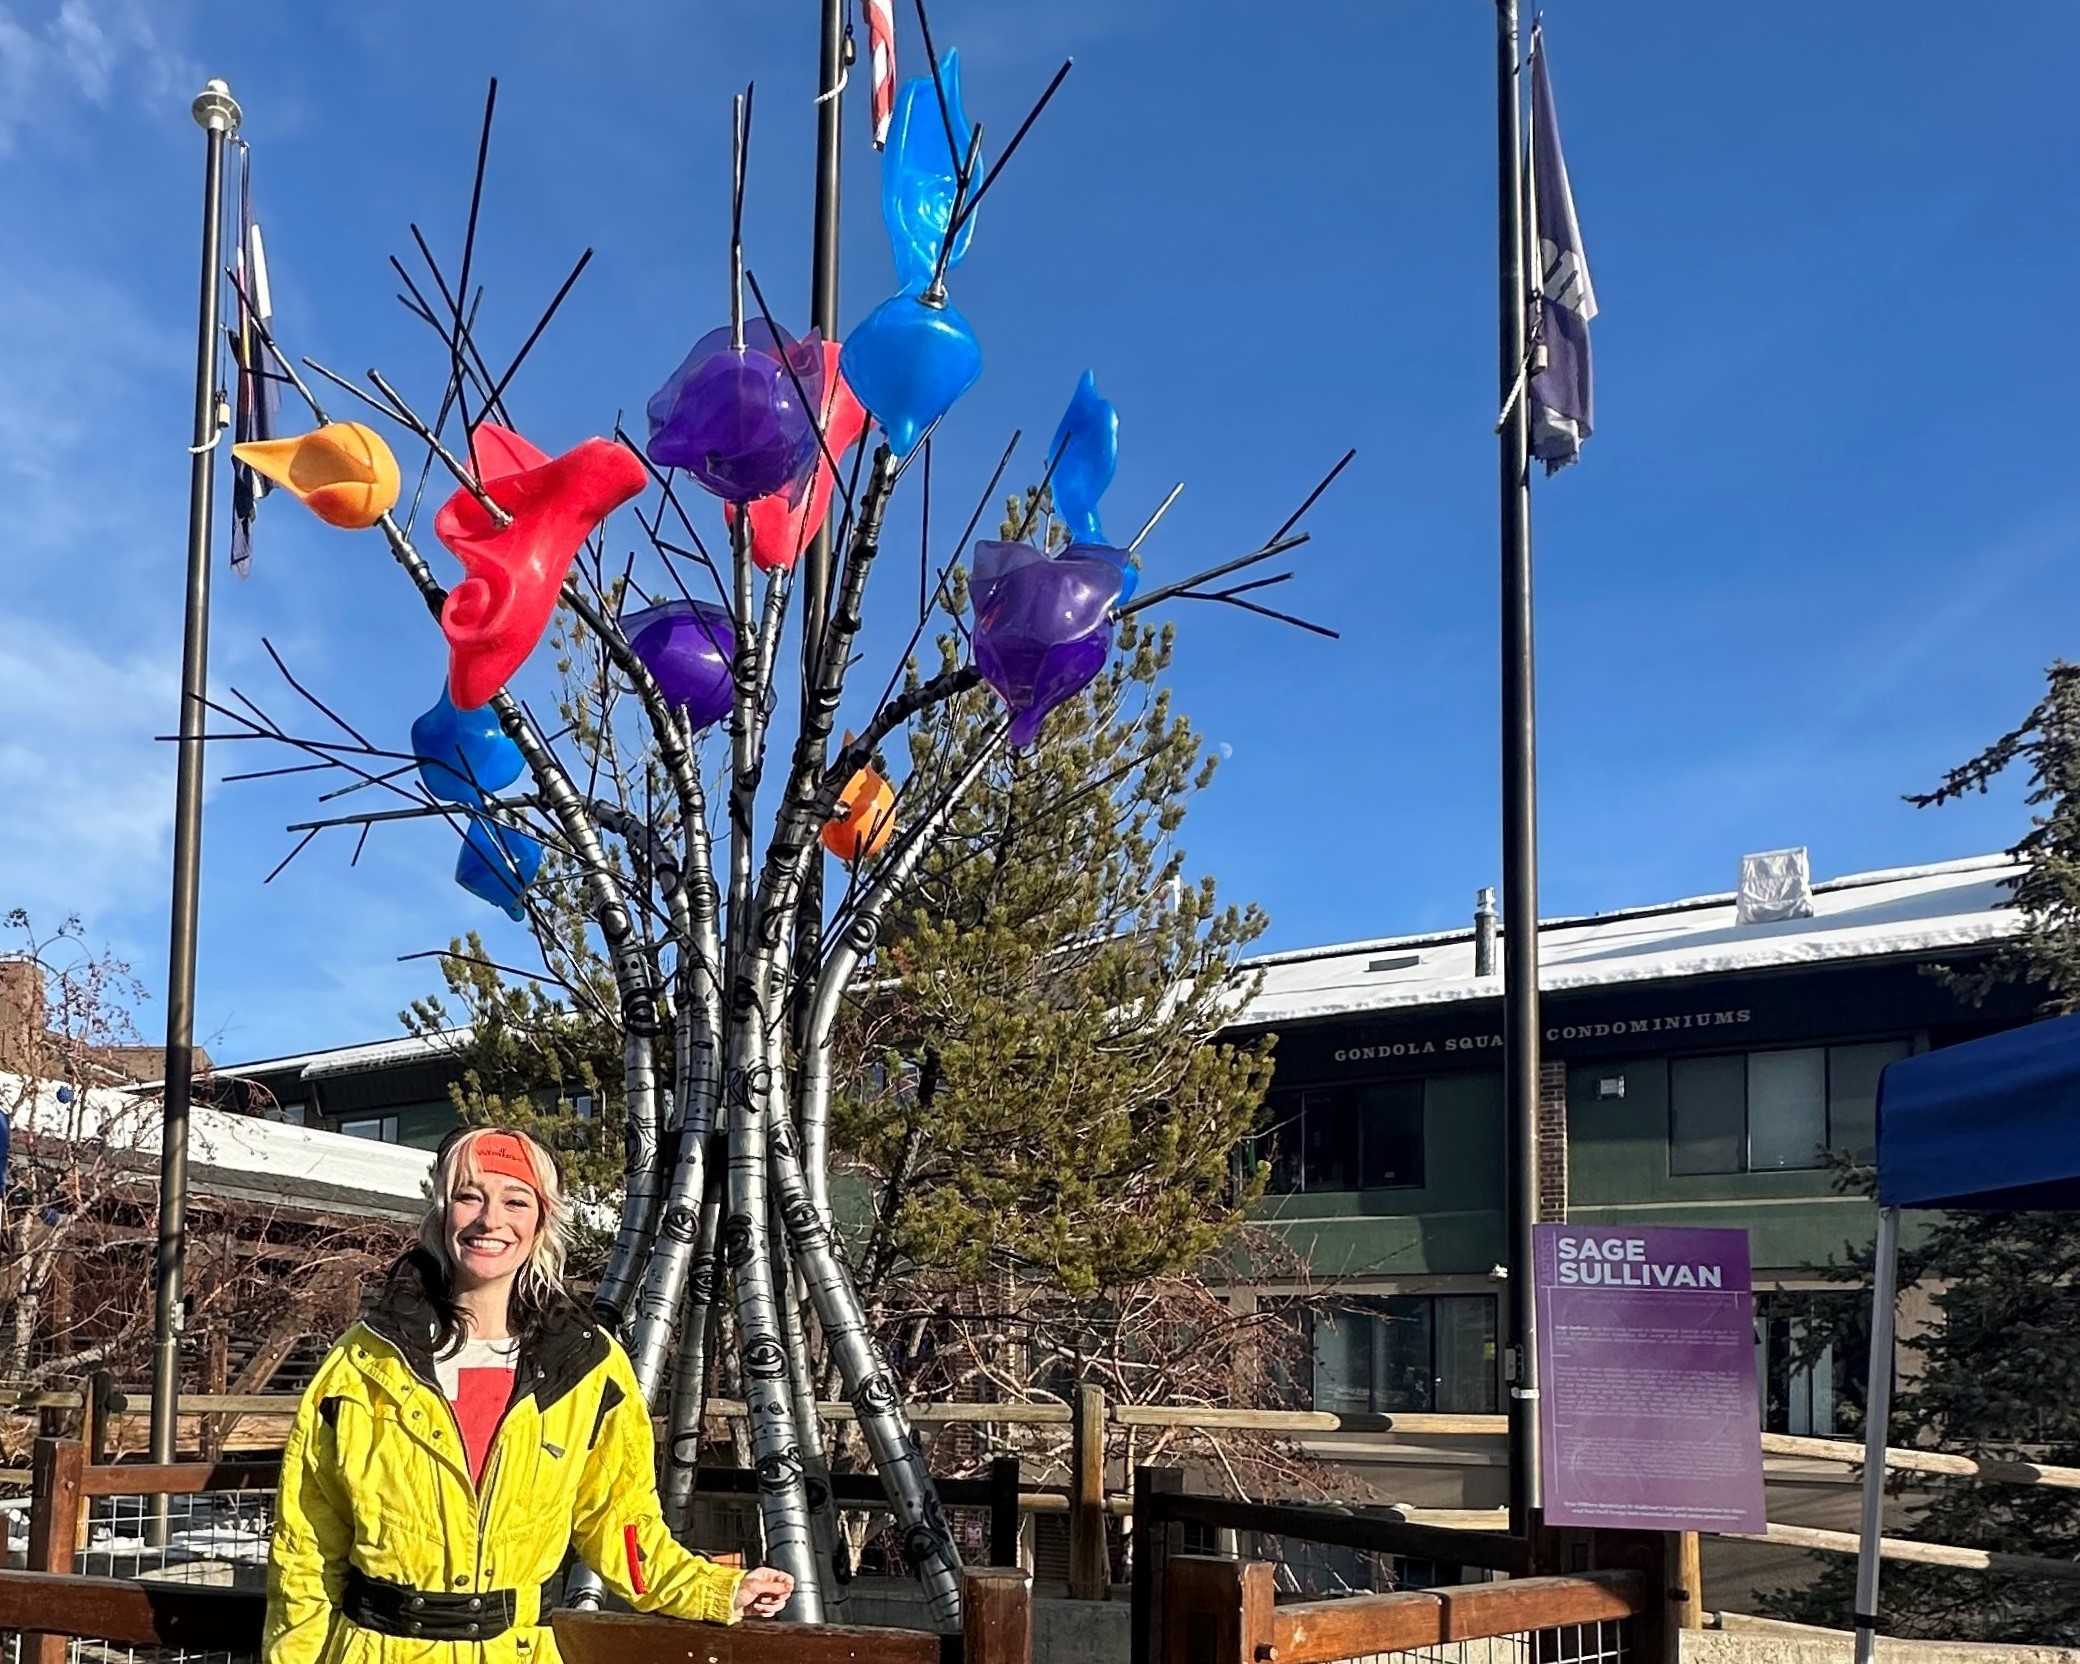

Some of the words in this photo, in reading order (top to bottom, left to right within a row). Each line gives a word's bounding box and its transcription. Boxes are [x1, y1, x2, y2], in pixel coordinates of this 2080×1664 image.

[1334, 1041, 1436, 1062] GONDOLA
[1445, 1034, 1504, 1051] SQUA
[1545, 1009, 1752, 1041] CONDOMINIUMS
[1540, 1235, 1553, 1282] ARTIST
[1558, 1237, 1646, 1262] SAGE
[1559, 1262, 1722, 1288] SULLIVAN
